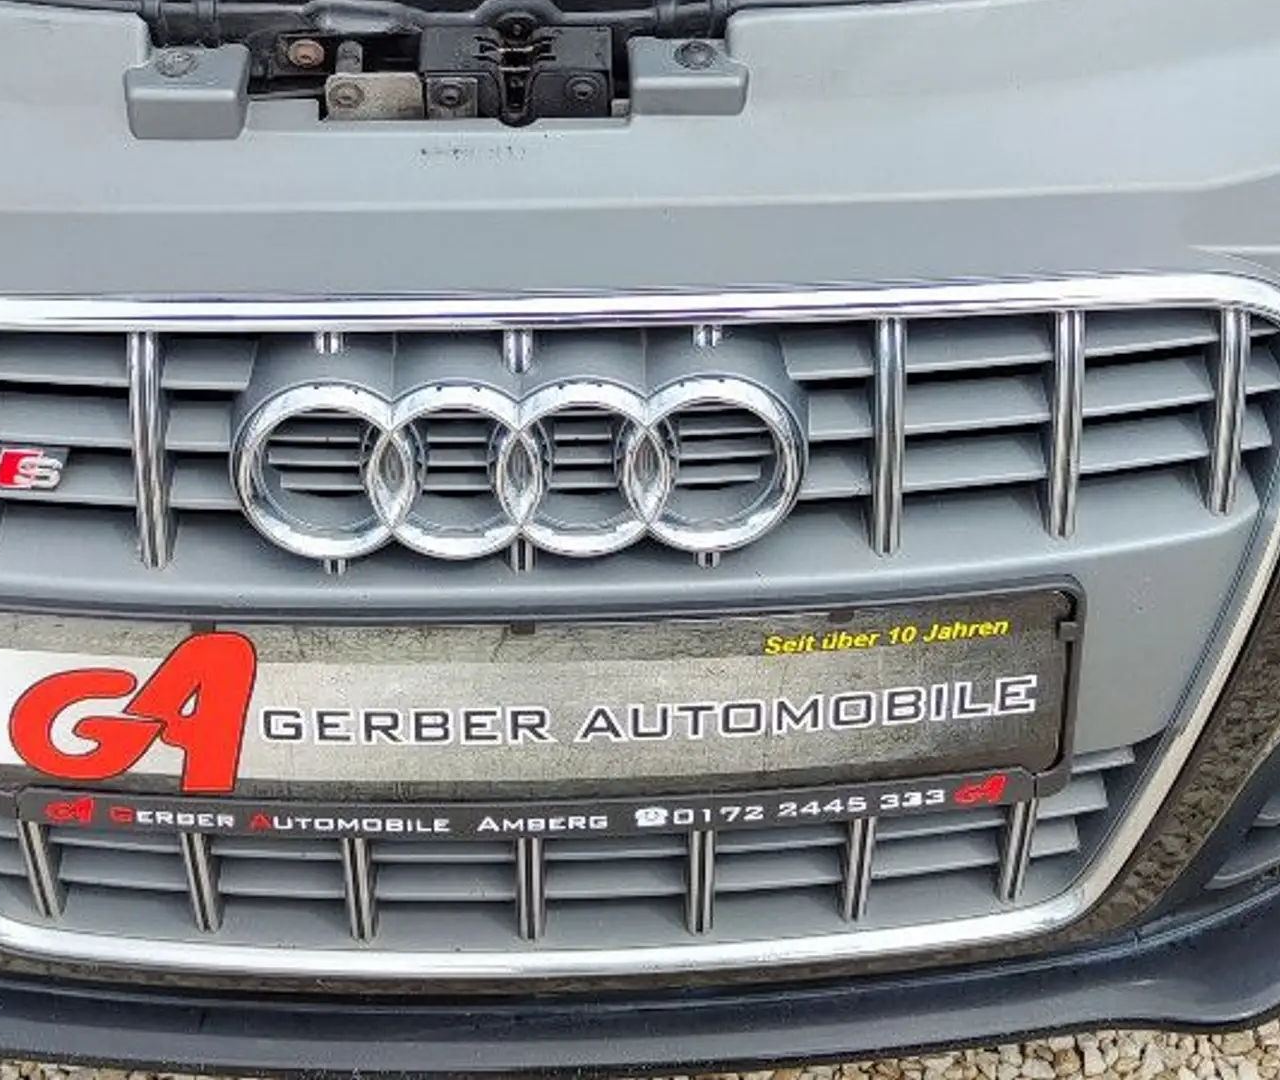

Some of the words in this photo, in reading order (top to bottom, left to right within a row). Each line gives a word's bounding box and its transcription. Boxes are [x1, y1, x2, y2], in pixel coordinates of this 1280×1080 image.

[764, 635, 815, 655] Seit
[822, 631, 880, 651] über
[888, 626, 919, 645] 10
[922, 619, 1010, 644] Jahren
[8, 630, 257, 793] GA
[260, 705, 557, 745] GERBER
[575, 674, 1038, 744] AUTOMOBILE
[109, 804, 235, 828] GERBER
[250, 810, 451, 832] AUTOMOBILE
[476, 815, 609, 833] AMBERG
[672, 805, 765, 826] 0172
[776, 796, 868, 818] 2445
[879, 788, 946, 810] 333
[951, 772, 1009, 809] GA
